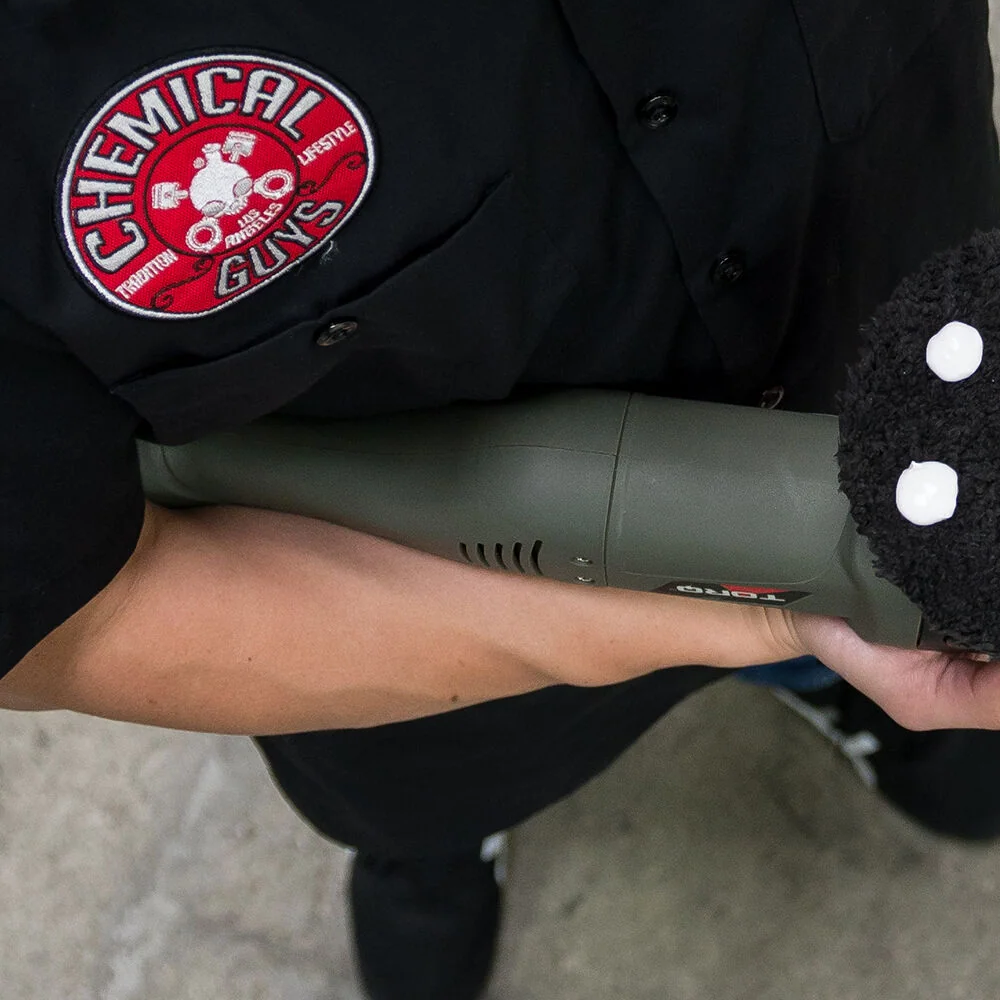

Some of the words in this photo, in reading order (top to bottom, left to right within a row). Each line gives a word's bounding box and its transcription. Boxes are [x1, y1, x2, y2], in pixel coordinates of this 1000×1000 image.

[297, 119, 357, 166] LIFESTYLE
[76, 66, 325, 273] CHEMICAL
[225, 202, 283, 249] ANGELES
[237, 208, 261, 228] LOS
[214, 200, 345, 299] GUYS
[114, 249, 179, 299] TRADITION
[676, 585, 786, 602] TORQ
